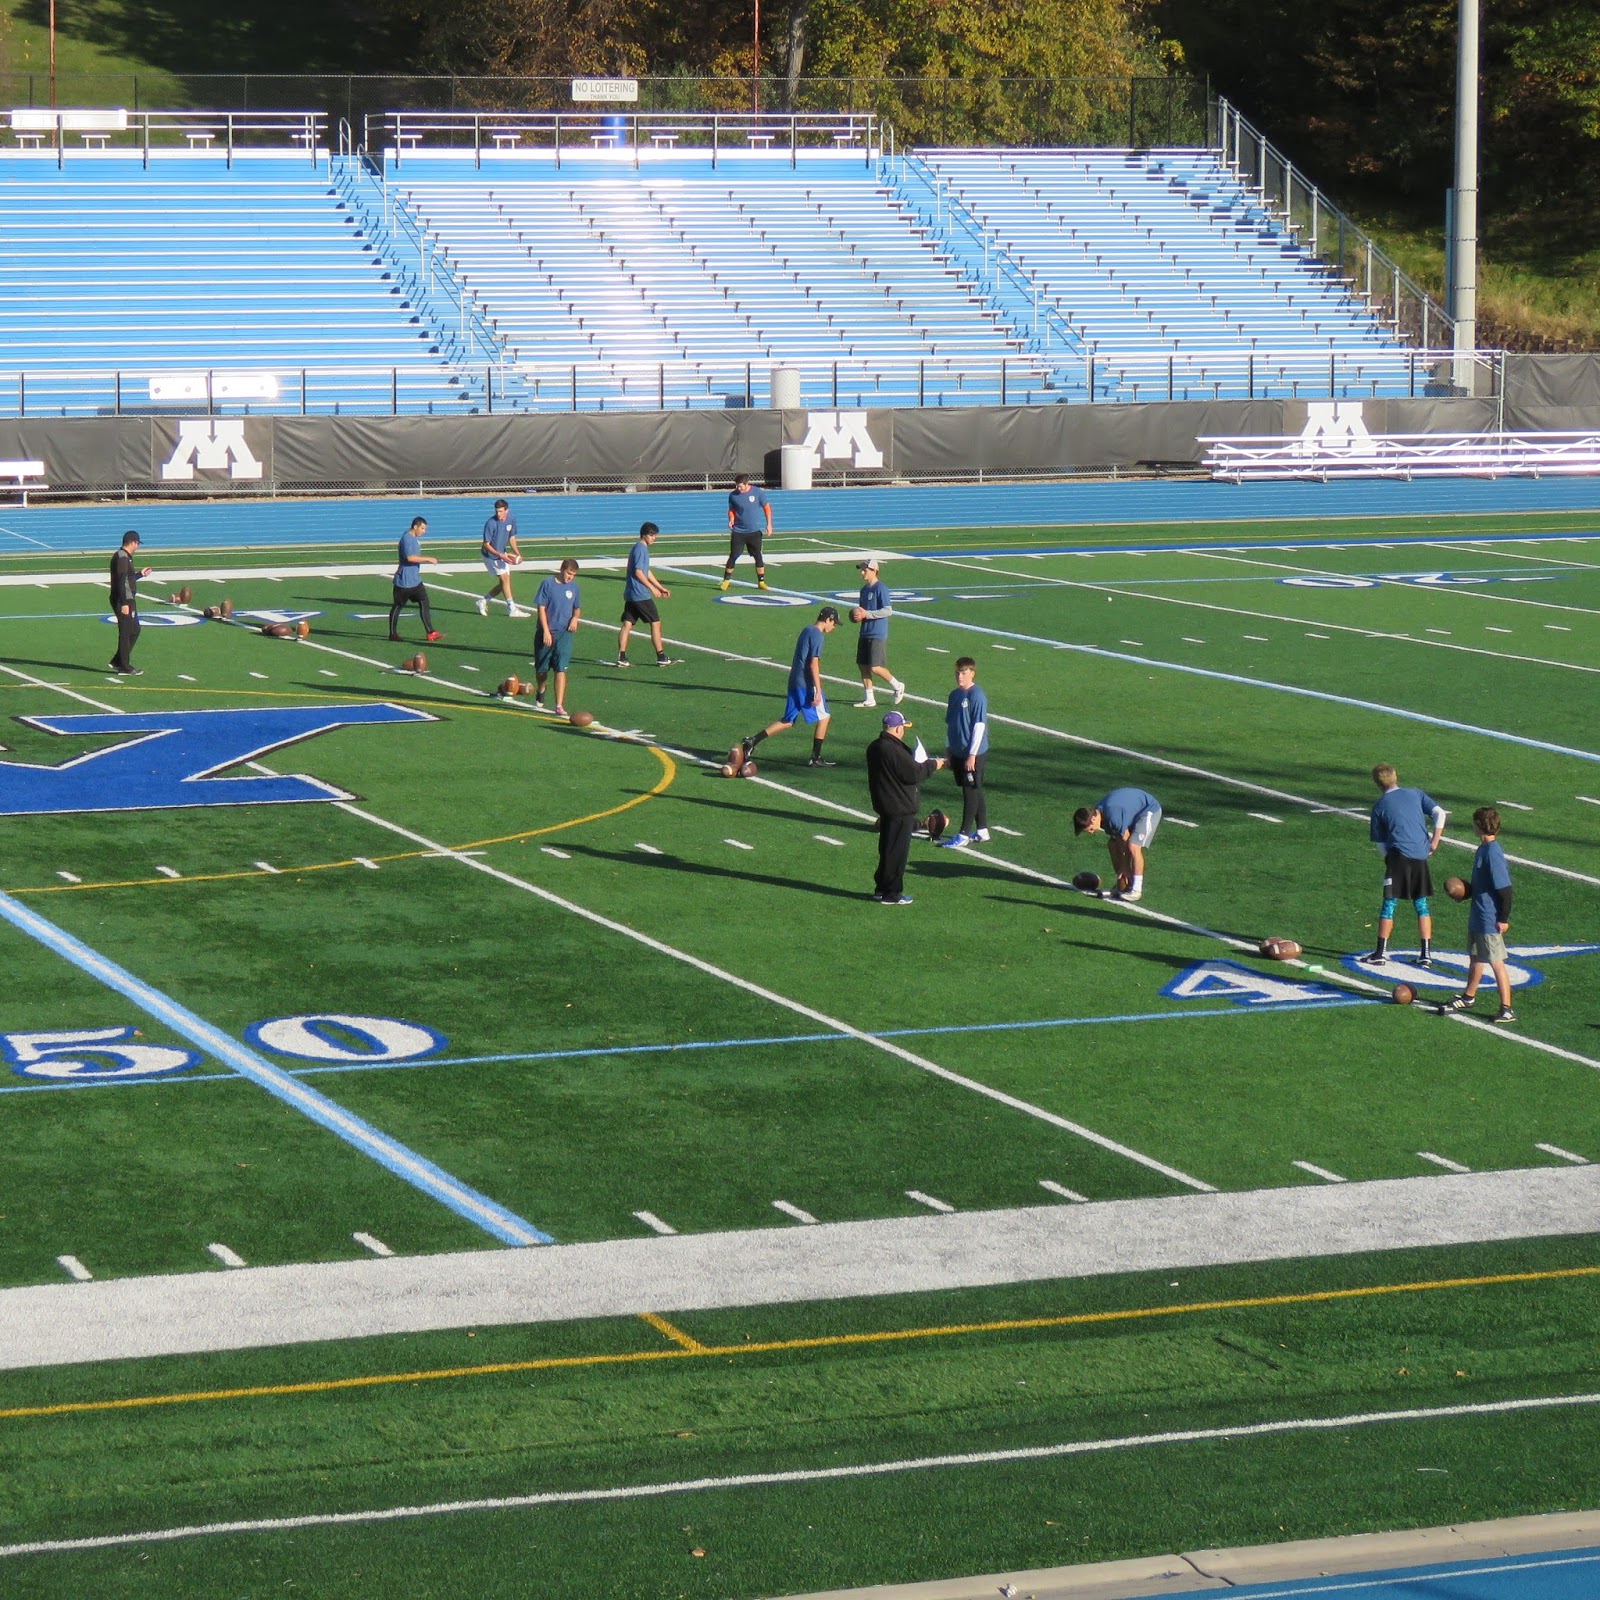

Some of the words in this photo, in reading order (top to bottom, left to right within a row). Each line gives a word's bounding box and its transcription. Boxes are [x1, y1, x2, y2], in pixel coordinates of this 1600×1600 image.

[575, 82, 588, 93] NO
[590, 82, 635, 93] LOITERING
[162, 420, 263, 479] M
[798, 411, 883, 468] M
[1291, 402, 1377, 456] M
[0, 1013, 449, 1080] 50
